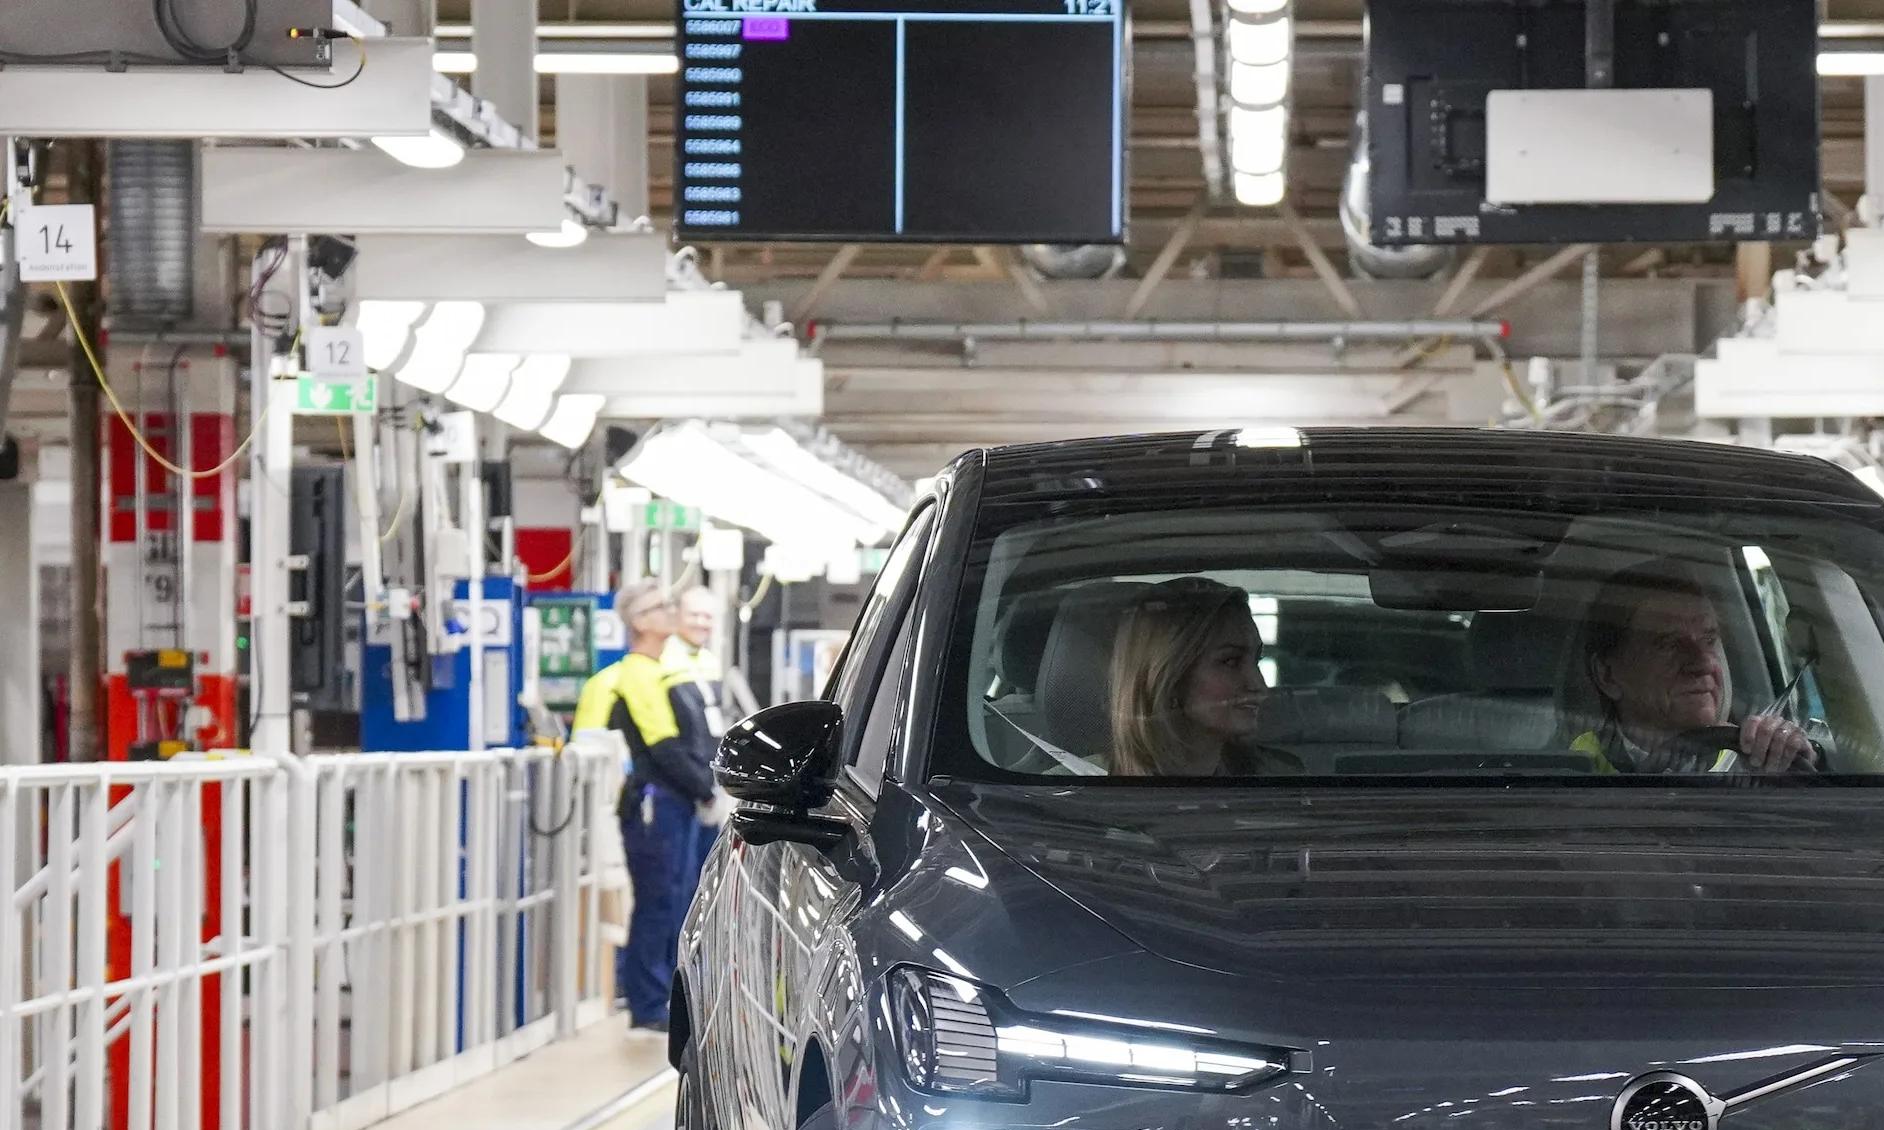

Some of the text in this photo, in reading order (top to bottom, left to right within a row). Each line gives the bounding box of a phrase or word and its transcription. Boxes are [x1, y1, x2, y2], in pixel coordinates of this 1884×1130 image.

[732, 0, 816, 12] REPAIR
[39, 224, 73, 254] 14
[326, 340, 350, 364] 12
